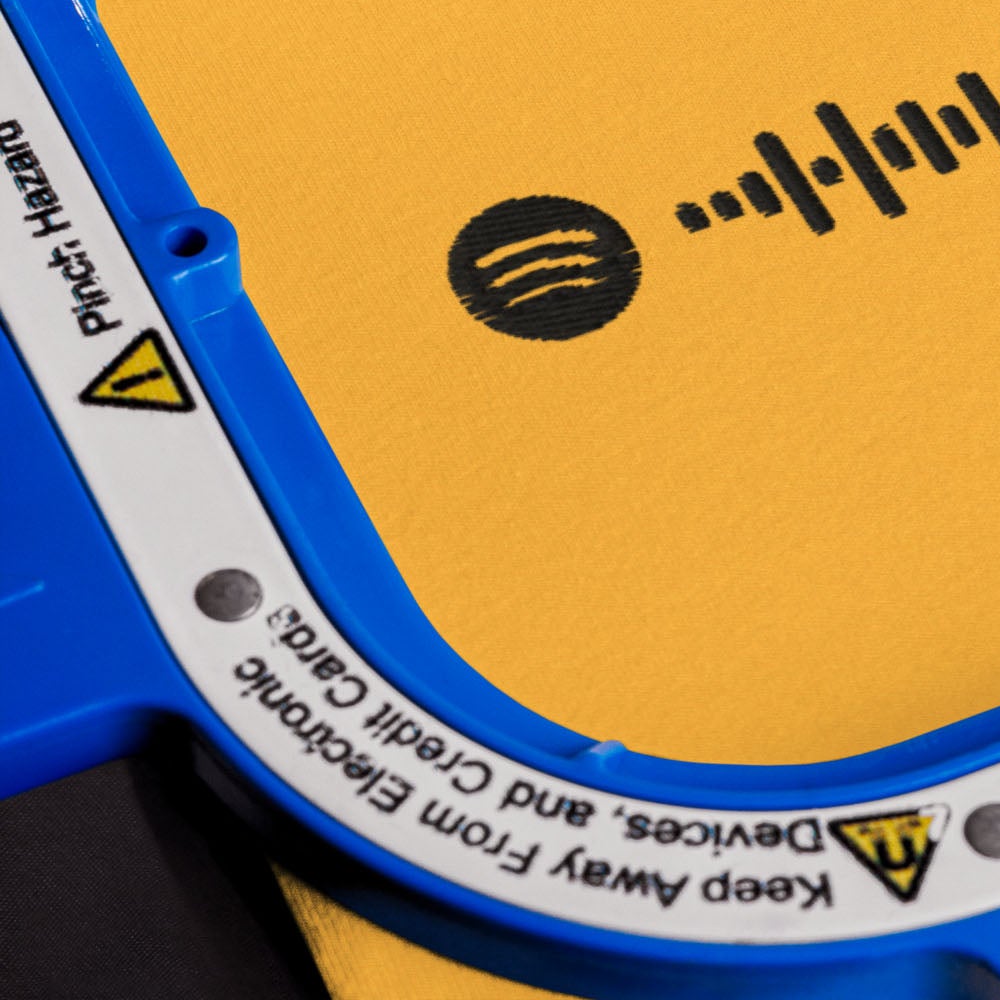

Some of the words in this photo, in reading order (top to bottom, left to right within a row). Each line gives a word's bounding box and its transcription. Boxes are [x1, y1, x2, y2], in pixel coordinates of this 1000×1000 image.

[47, 238, 124, 338] Pinch
[232, 656, 417, 815] Electronic
[361, 701, 494, 796] Credit
[418, 798, 542, 876] From
[497, 779, 597, 829] and
[611, 804, 826, 858] Devices,
[548, 846, 690, 909] Away
[702, 871, 835, 910] Keep
